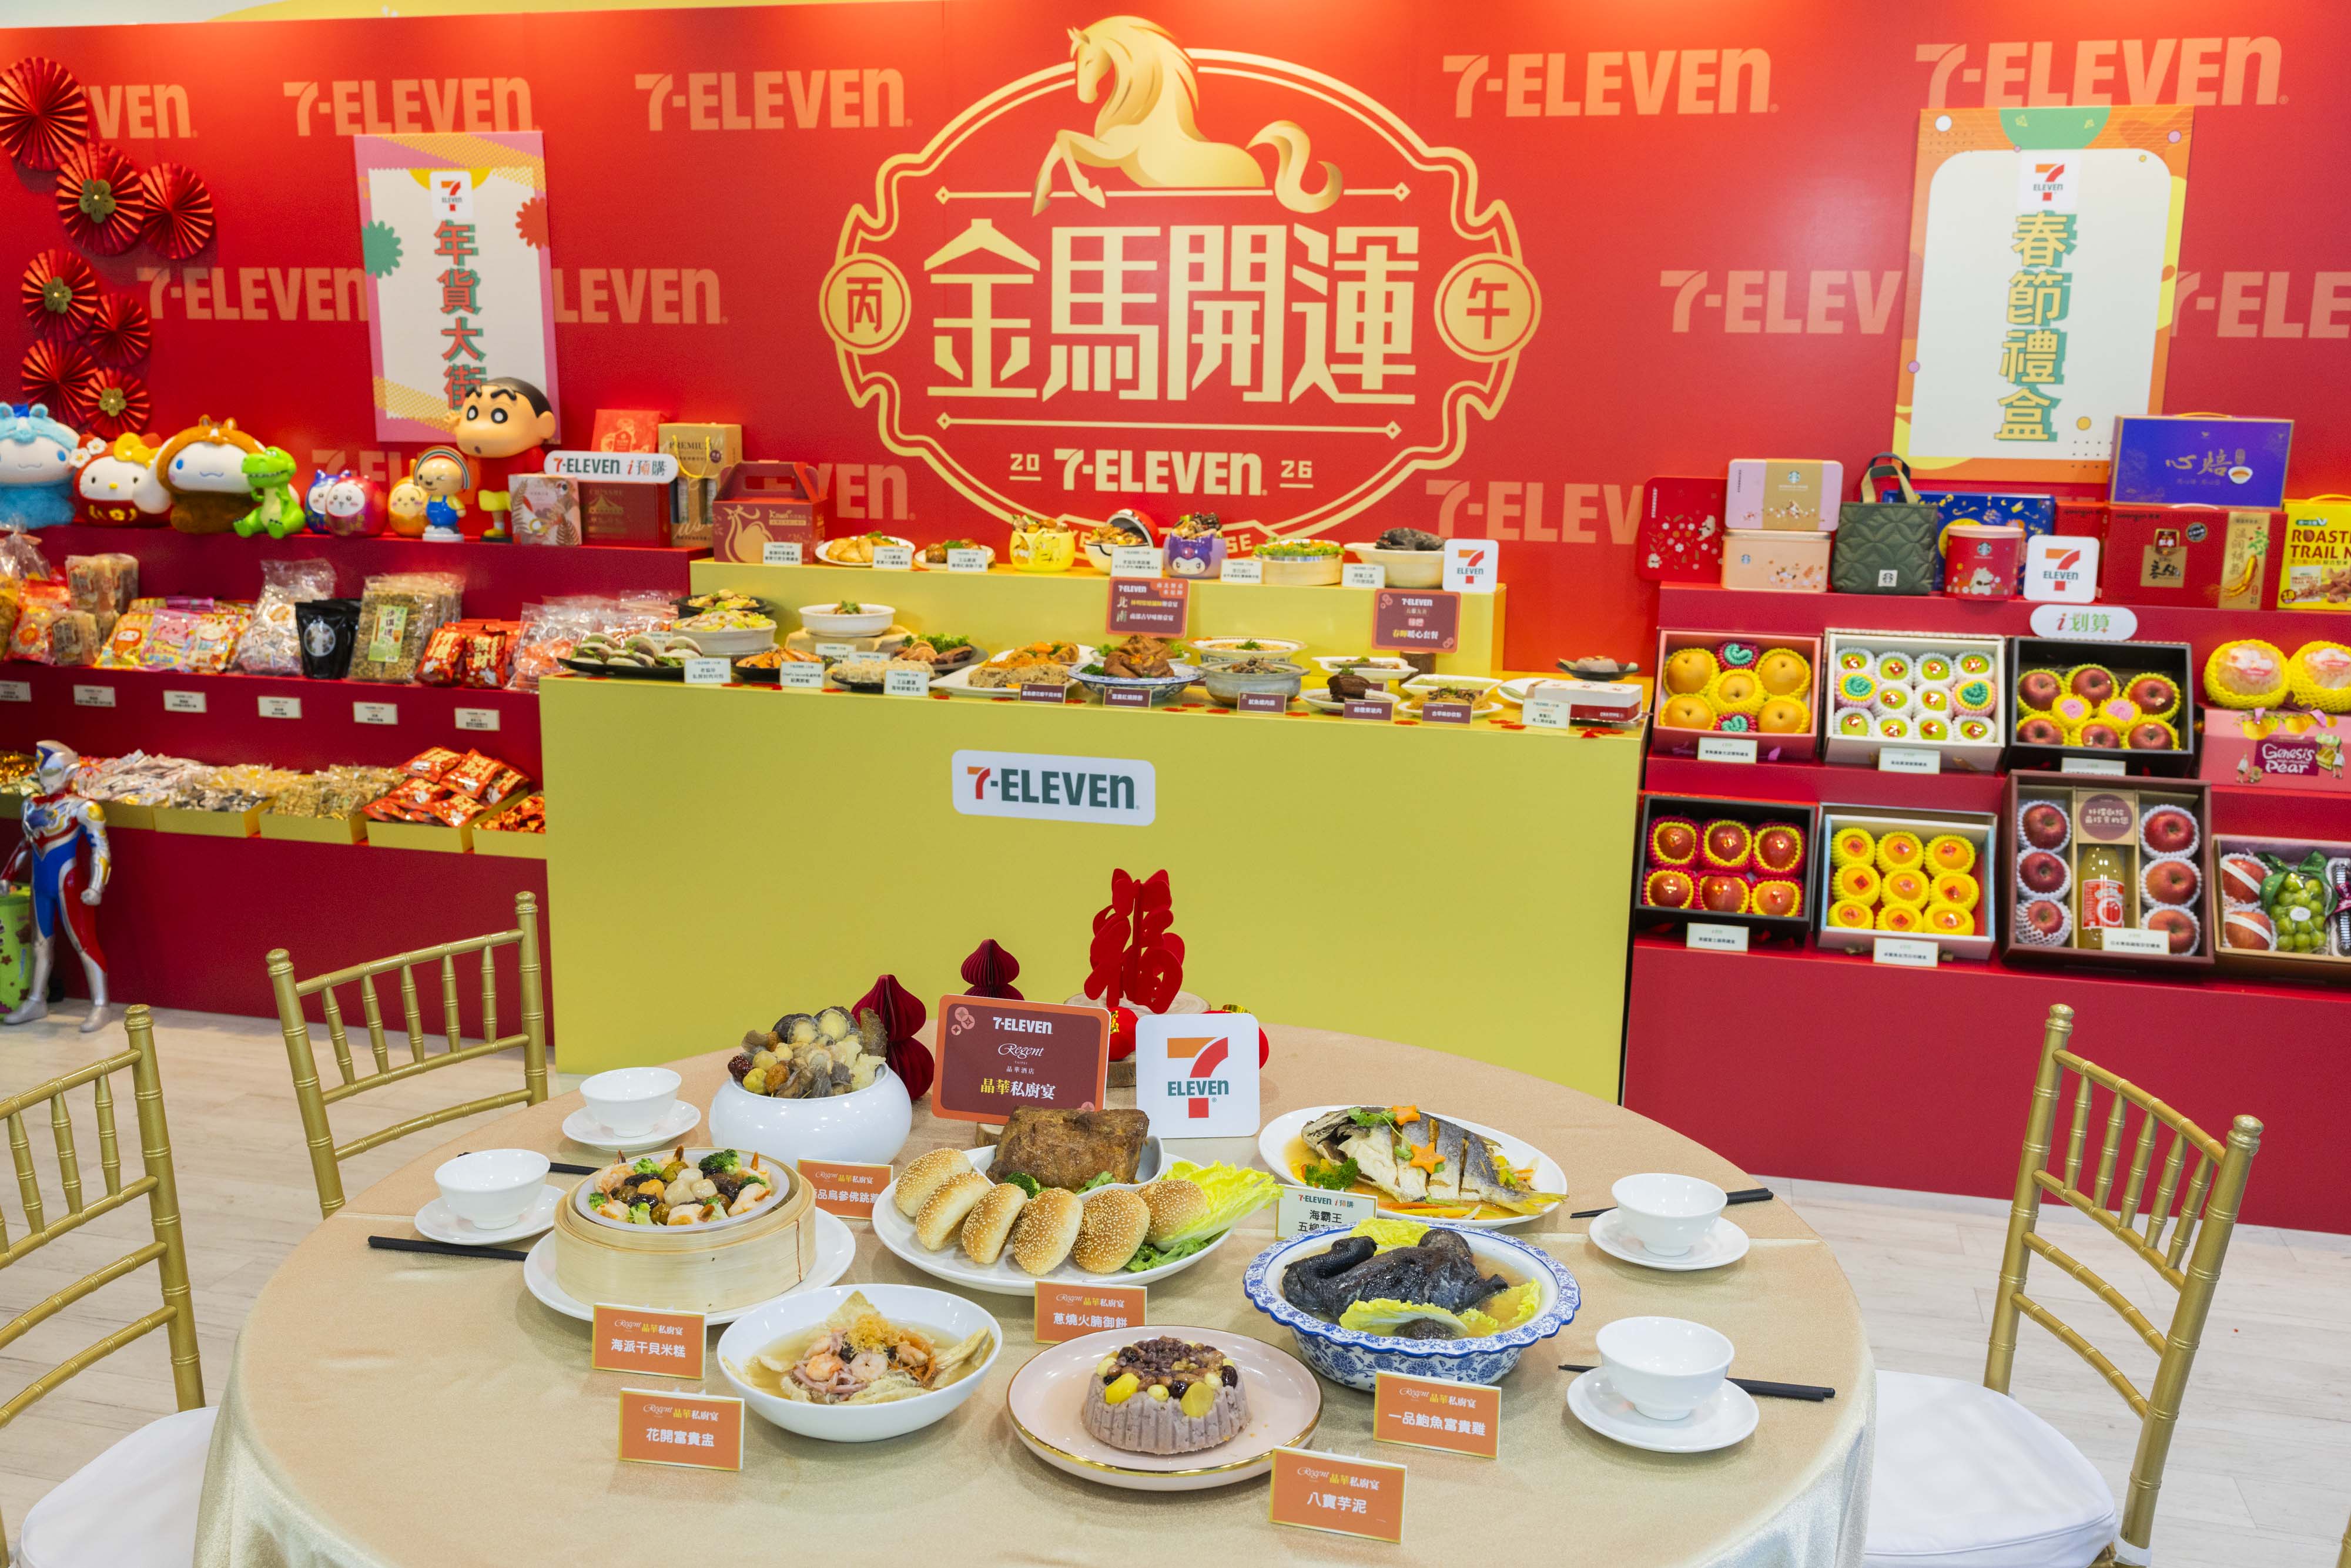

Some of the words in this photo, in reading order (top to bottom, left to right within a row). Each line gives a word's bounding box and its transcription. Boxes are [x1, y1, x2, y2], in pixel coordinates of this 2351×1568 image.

[847, 277, 883, 333] 丙
[925, 218, 1419, 405] 金馬開運
[1466, 277, 1511, 340] 午
[434, 220, 485, 410] 年貨大街
[1994, 210, 2076, 441] 春節禮盒
[1010, 453, 1040, 472] 20
[1280, 460, 1313, 478] 26
[2292, 529, 2351, 544] ROAST
[2290, 545, 2338, 559] TRAIL
[2262, 743, 2315, 762] Genesis
[2265, 759, 2309, 773] Pear
[998, 1043, 1044, 1058] Regent
[1006, 1066, 1034, 1074] 晶華酒店
[980, 1077, 1056, 1100] 晶華私廚宴
[838, 1175, 873, 1185] 晶華私廚宴
[1309, 1209, 1342, 1224] 海霸王
[1083, 1297, 1125, 1308] 晶華私廚宴
[641, 1323, 683, 1336] 晶華私廚宴
[611, 1338, 686, 1358] 海派干貝米糕
[1429, 1393, 1477, 1409] 晶華私廚宴
[673, 1408, 719, 1422] 晶華私廚宴
[1388, 1411, 1486, 1436] 一品鮑魚富貴雞
[645, 1428, 715, 1448] 花開富貴盅
[1329, 1473, 1380, 1490] 晶華私廚宴
[1307, 1492, 1367, 1514] 八寶芋泥
